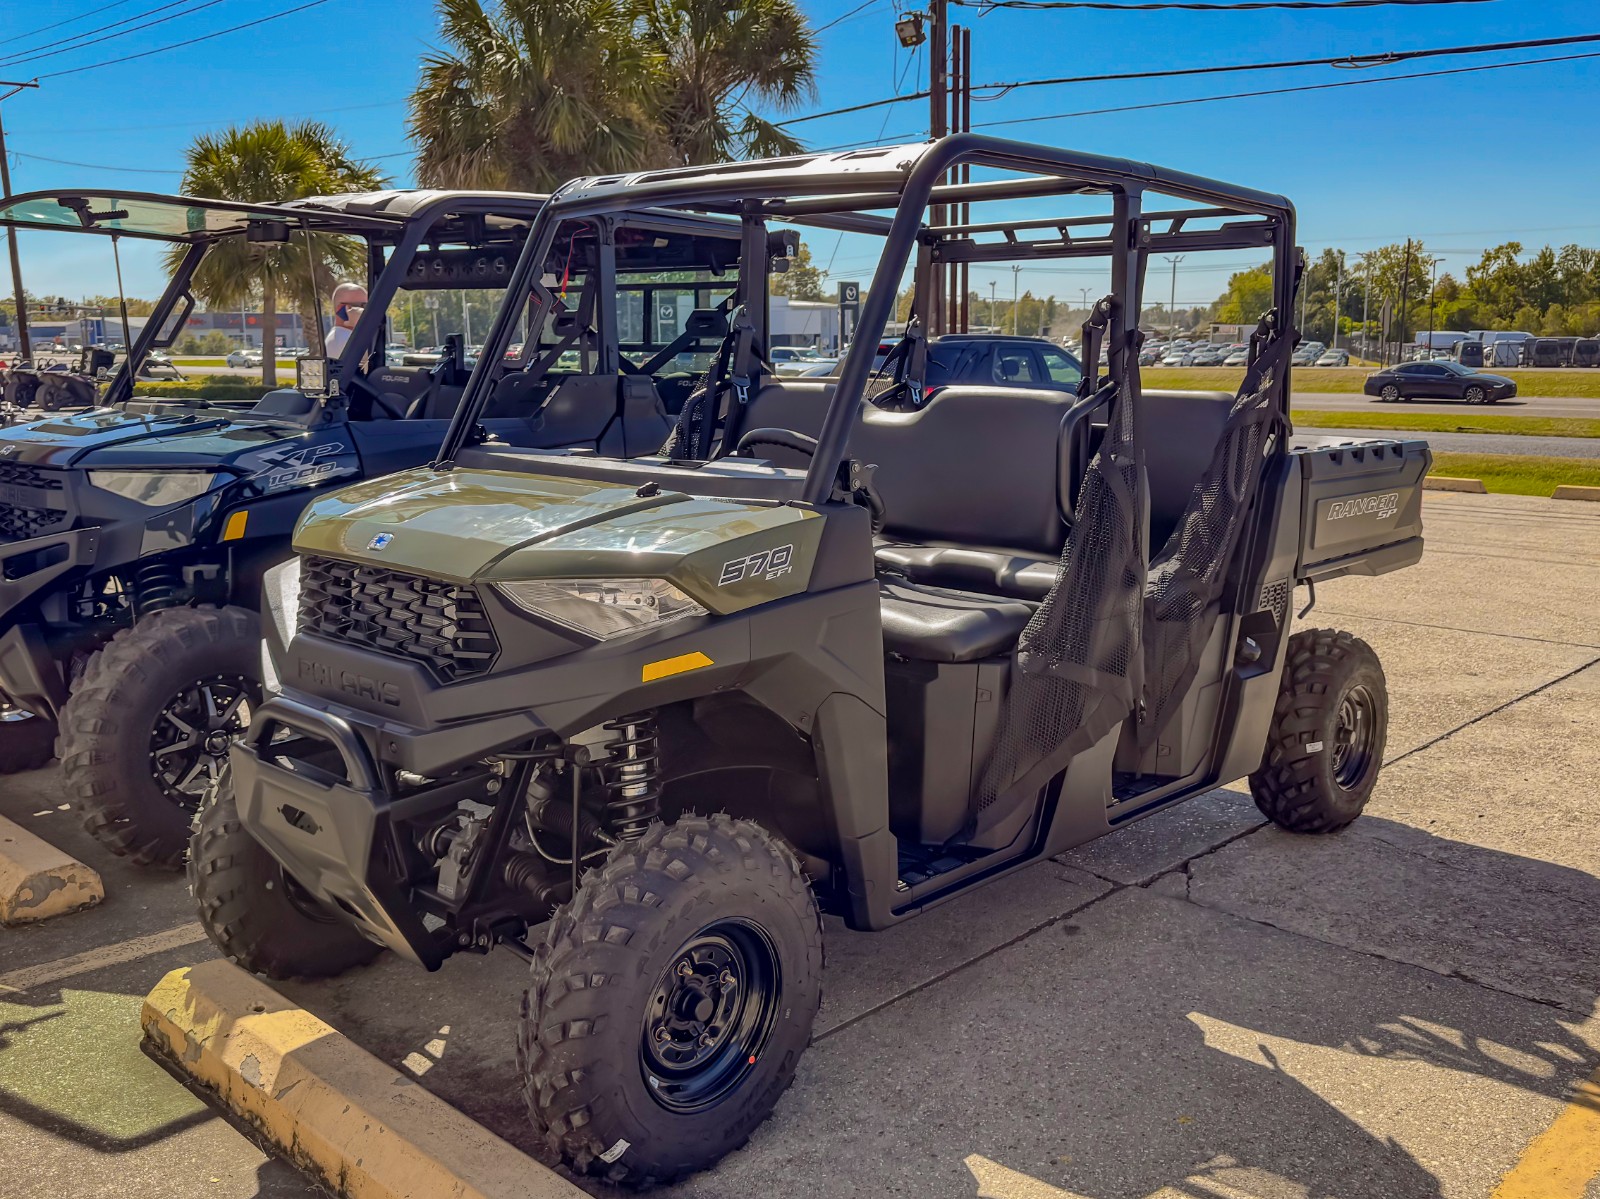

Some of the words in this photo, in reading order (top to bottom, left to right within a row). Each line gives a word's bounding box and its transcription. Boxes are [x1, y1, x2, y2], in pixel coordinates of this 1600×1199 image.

[246, 442, 345, 480] XP
[269, 461, 337, 488] 1000
[1327, 492, 1399, 520] RANGER
[1376, 508, 1398, 520] SP
[717, 543, 793, 587] 570
[765, 565, 793, 580] EFI
[298, 658, 400, 706] POLARIS
